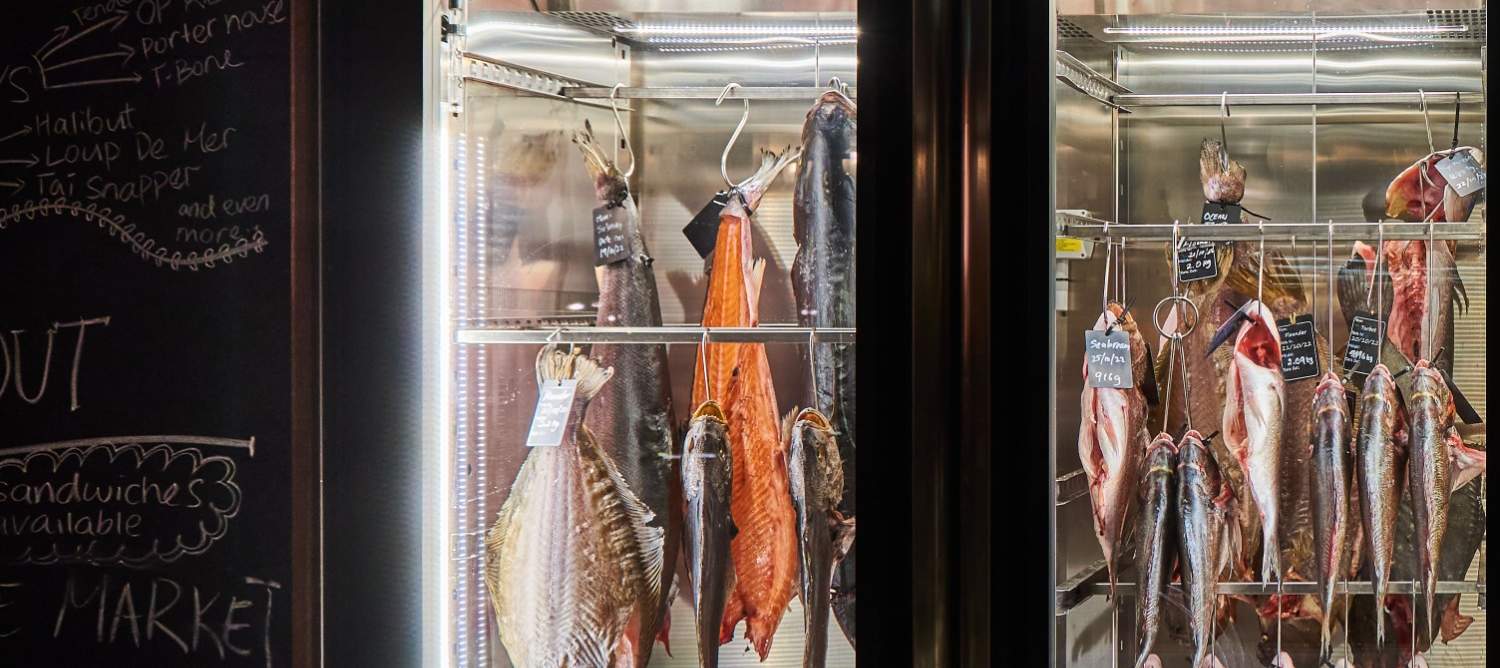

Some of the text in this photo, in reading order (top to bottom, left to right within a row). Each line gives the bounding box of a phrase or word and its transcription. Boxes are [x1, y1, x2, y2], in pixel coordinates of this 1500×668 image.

[36, 103, 136, 137] Halibut
[46, 122, 237, 171] Loup De Mer
[87, 165, 201, 205] Snapper
[178, 194, 269, 219] and even
[0, 316, 111, 411] UT
[0, 510, 142, 537] vailable
[53, 574, 281, 668] MARKET
